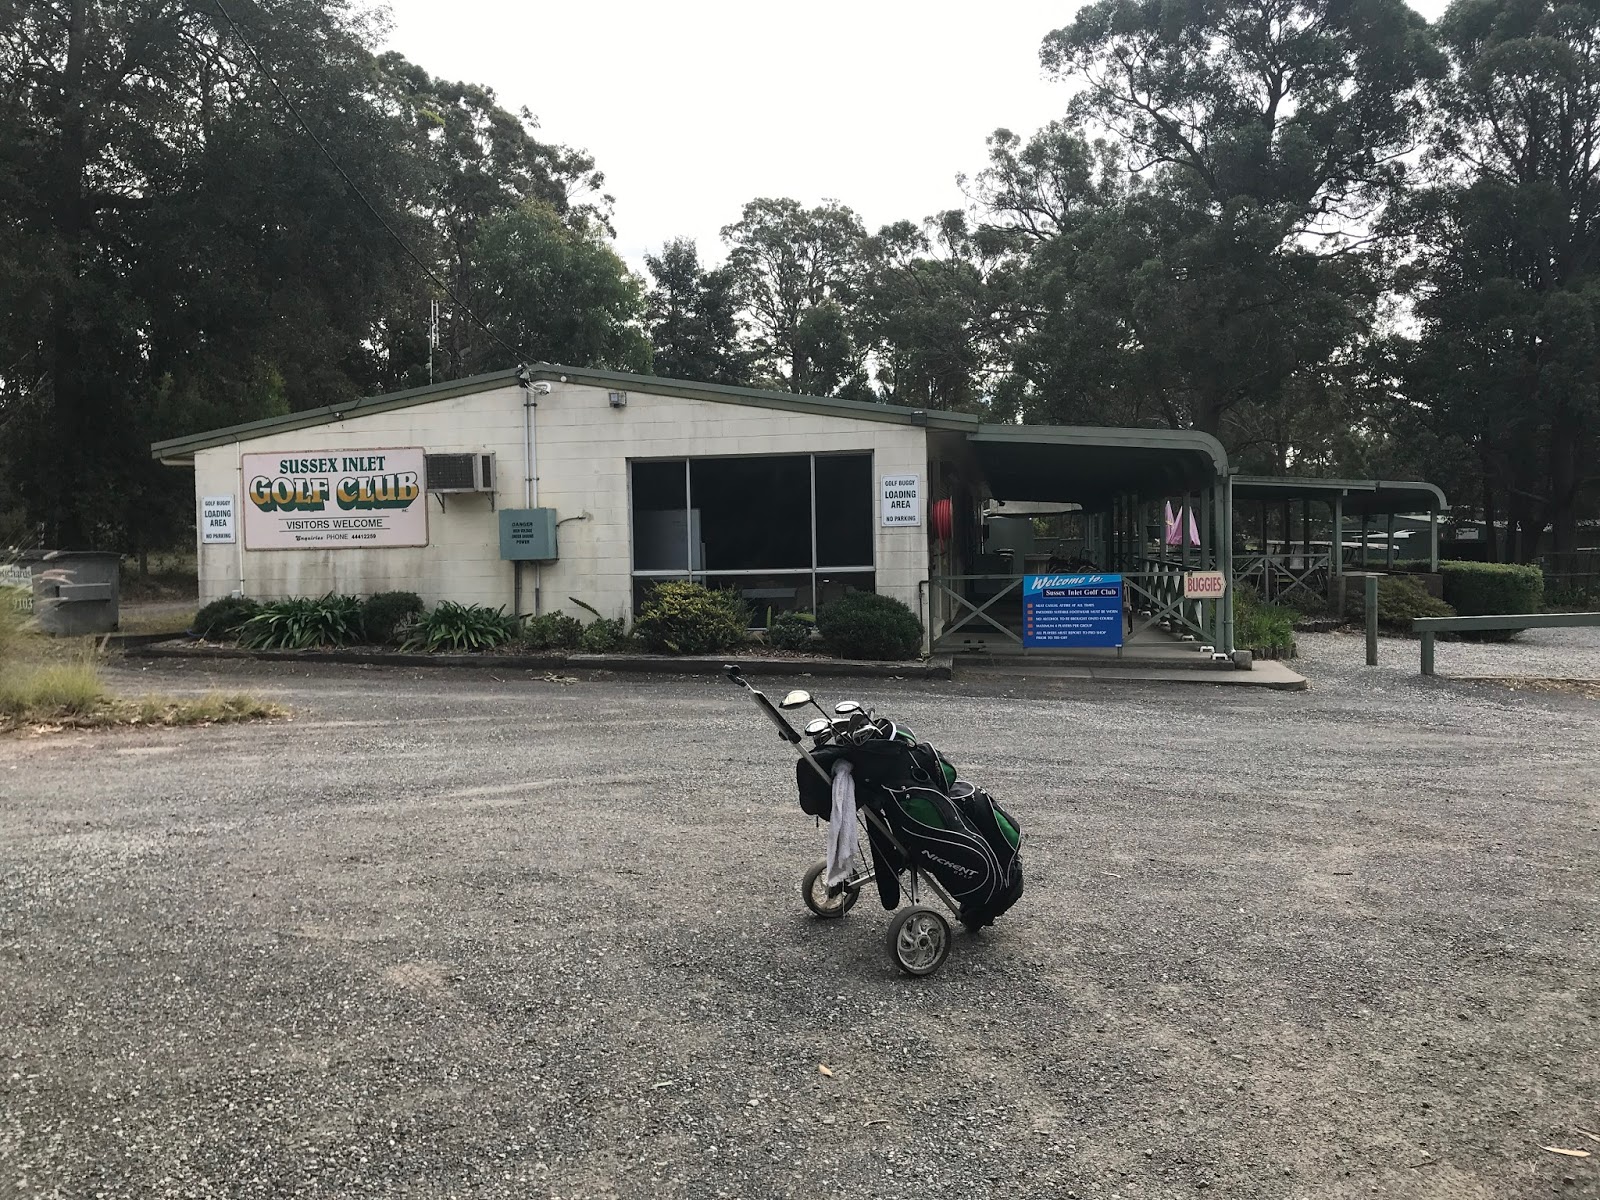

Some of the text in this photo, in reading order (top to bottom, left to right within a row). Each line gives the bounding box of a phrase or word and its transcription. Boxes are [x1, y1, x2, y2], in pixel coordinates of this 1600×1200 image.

[280, 456, 386, 474] SUSSEX INLET
[249, 471, 420, 512] GOLF CLUB
[884, 490, 916, 498] LOADING
[891, 500, 910, 508] AREA
[286, 519, 382, 530] VISITORS WELCOME
[1032, 576, 1086, 590] Welcome
[1188, 577, 1222, 592] BUGGIES
[922, 850, 979, 876] NICKENT
